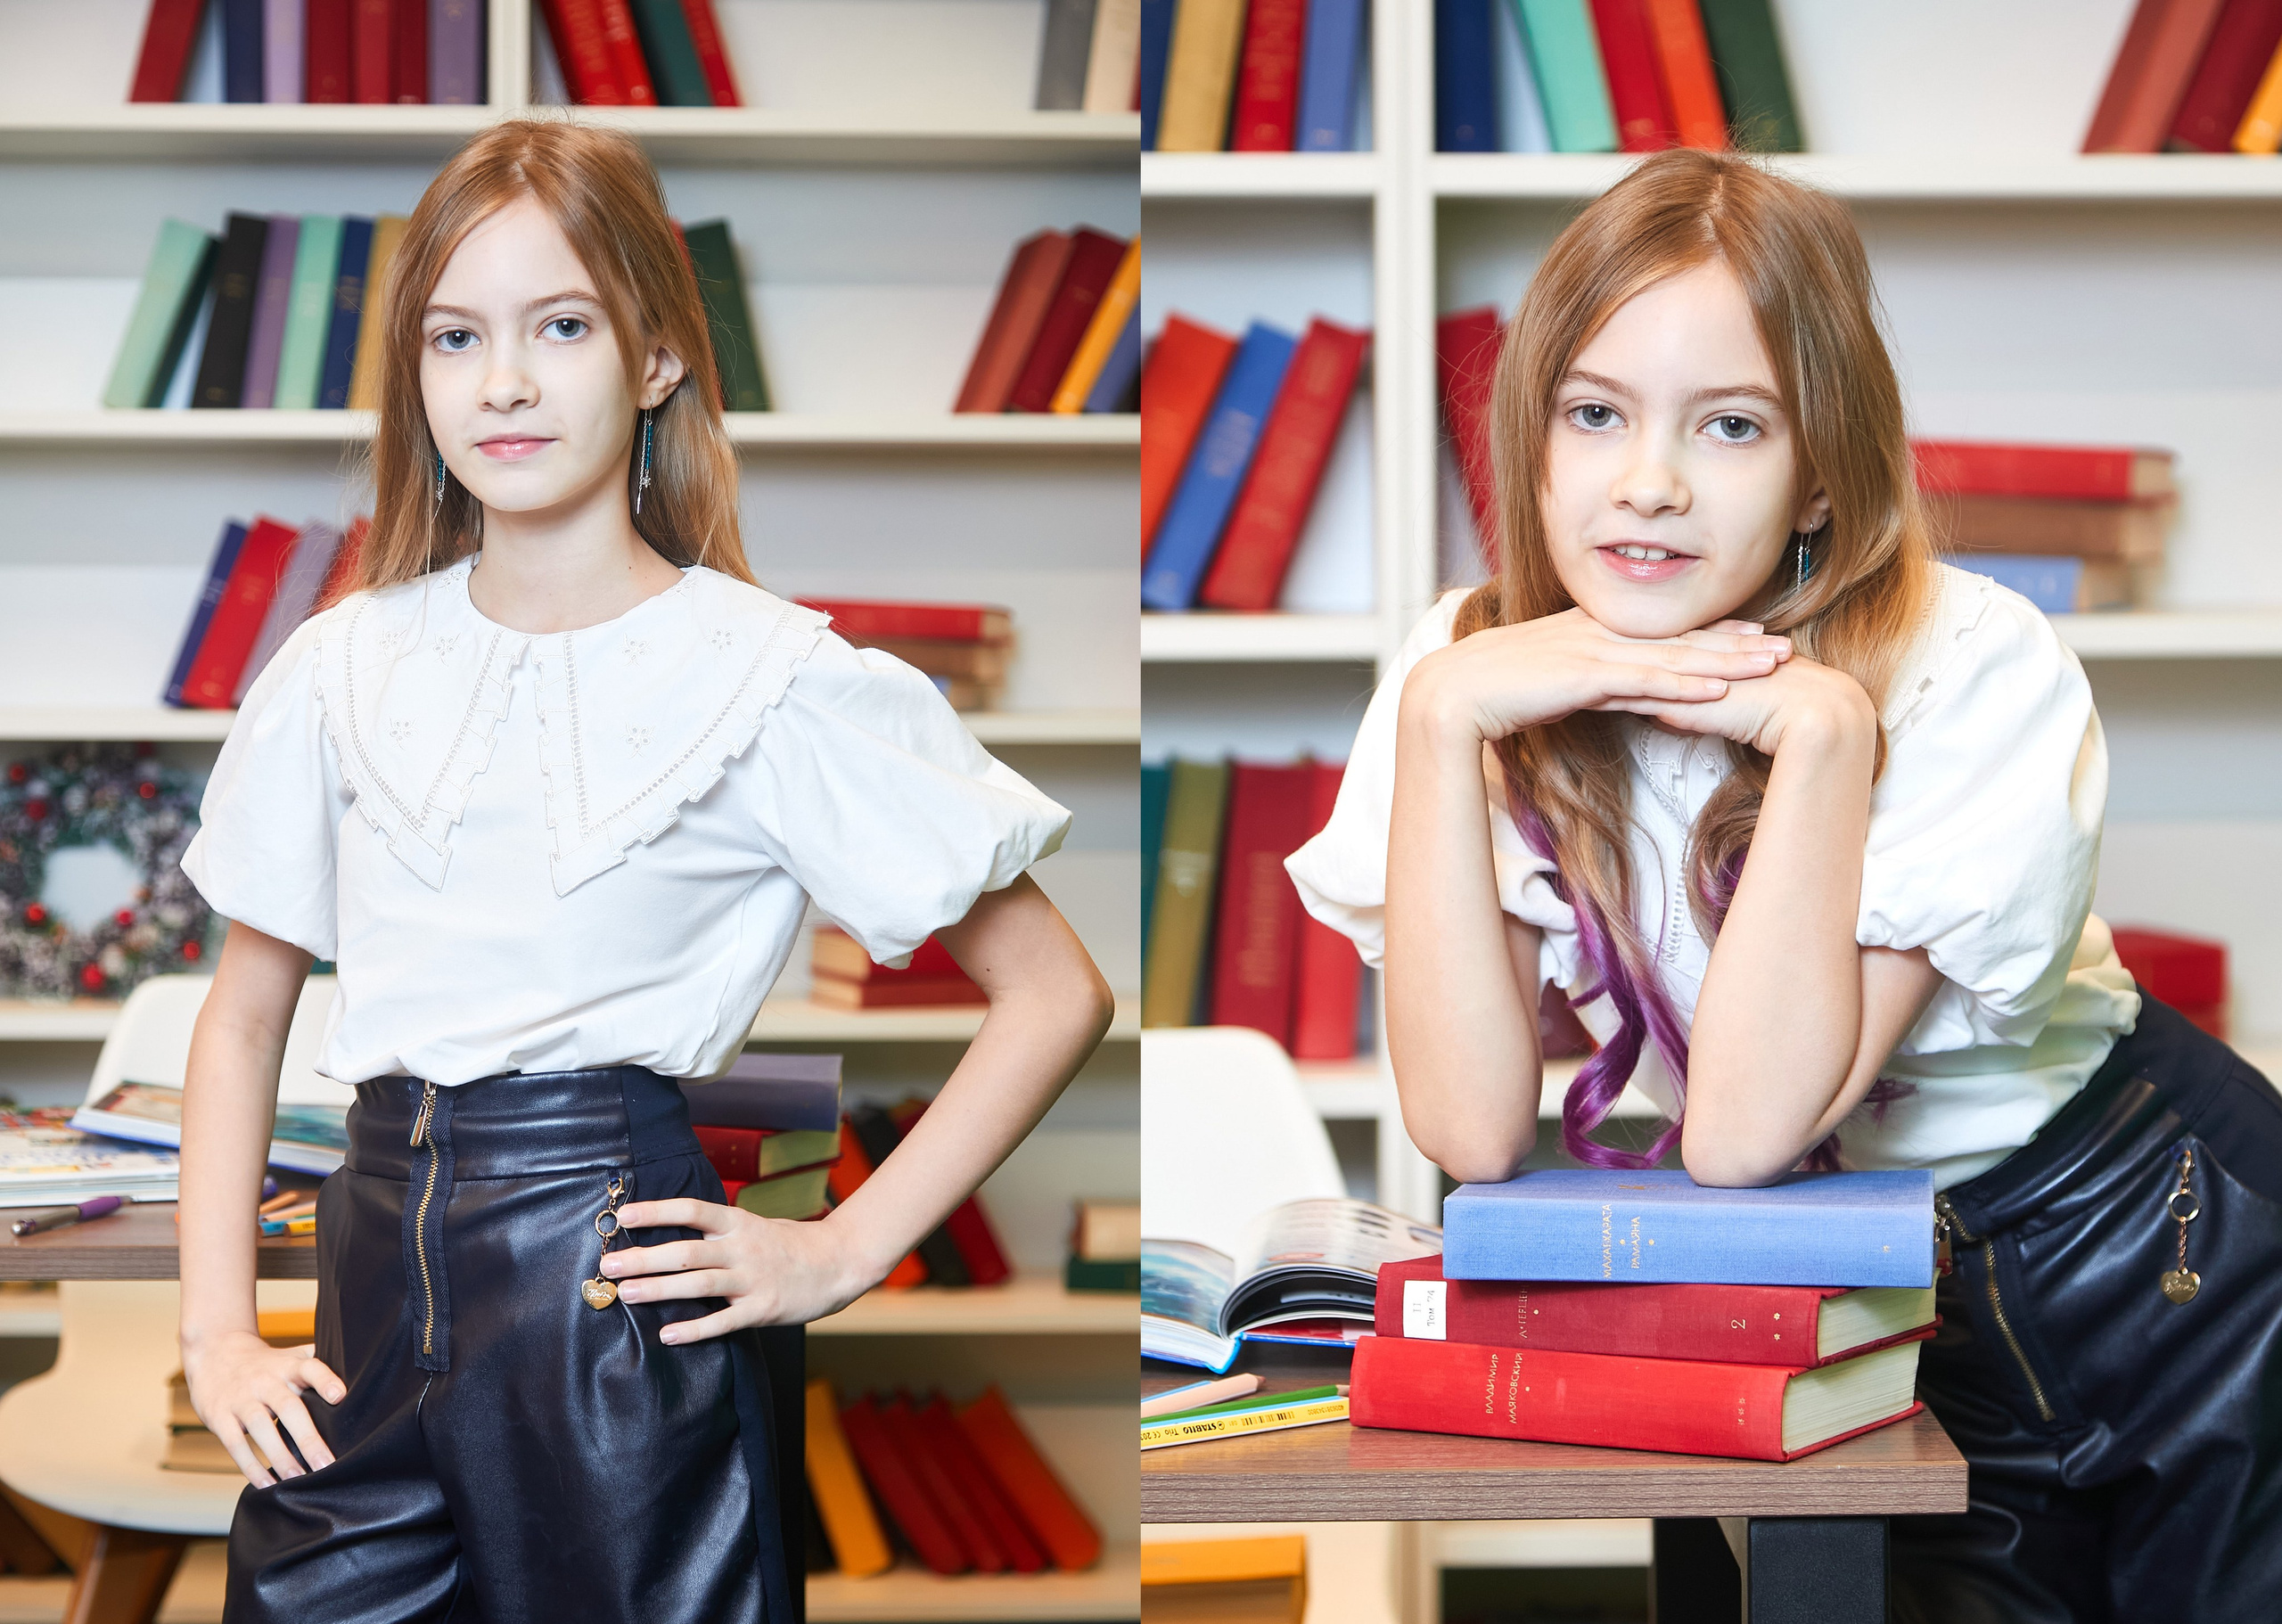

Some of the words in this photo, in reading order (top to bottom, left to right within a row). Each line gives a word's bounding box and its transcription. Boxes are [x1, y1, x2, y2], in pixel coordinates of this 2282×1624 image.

[1630, 1216, 1641, 1269] РАМАЯНА
[1730, 1318, 1746, 1330] 2
[1484, 1353, 1499, 1415] ВЛАДИМИР
[1508, 1352, 1523, 1424] МАЯКОВСКИЙ
[1164, 1428, 1179, 1437] Trio
[1183, 1423, 1217, 1434] STABILO
